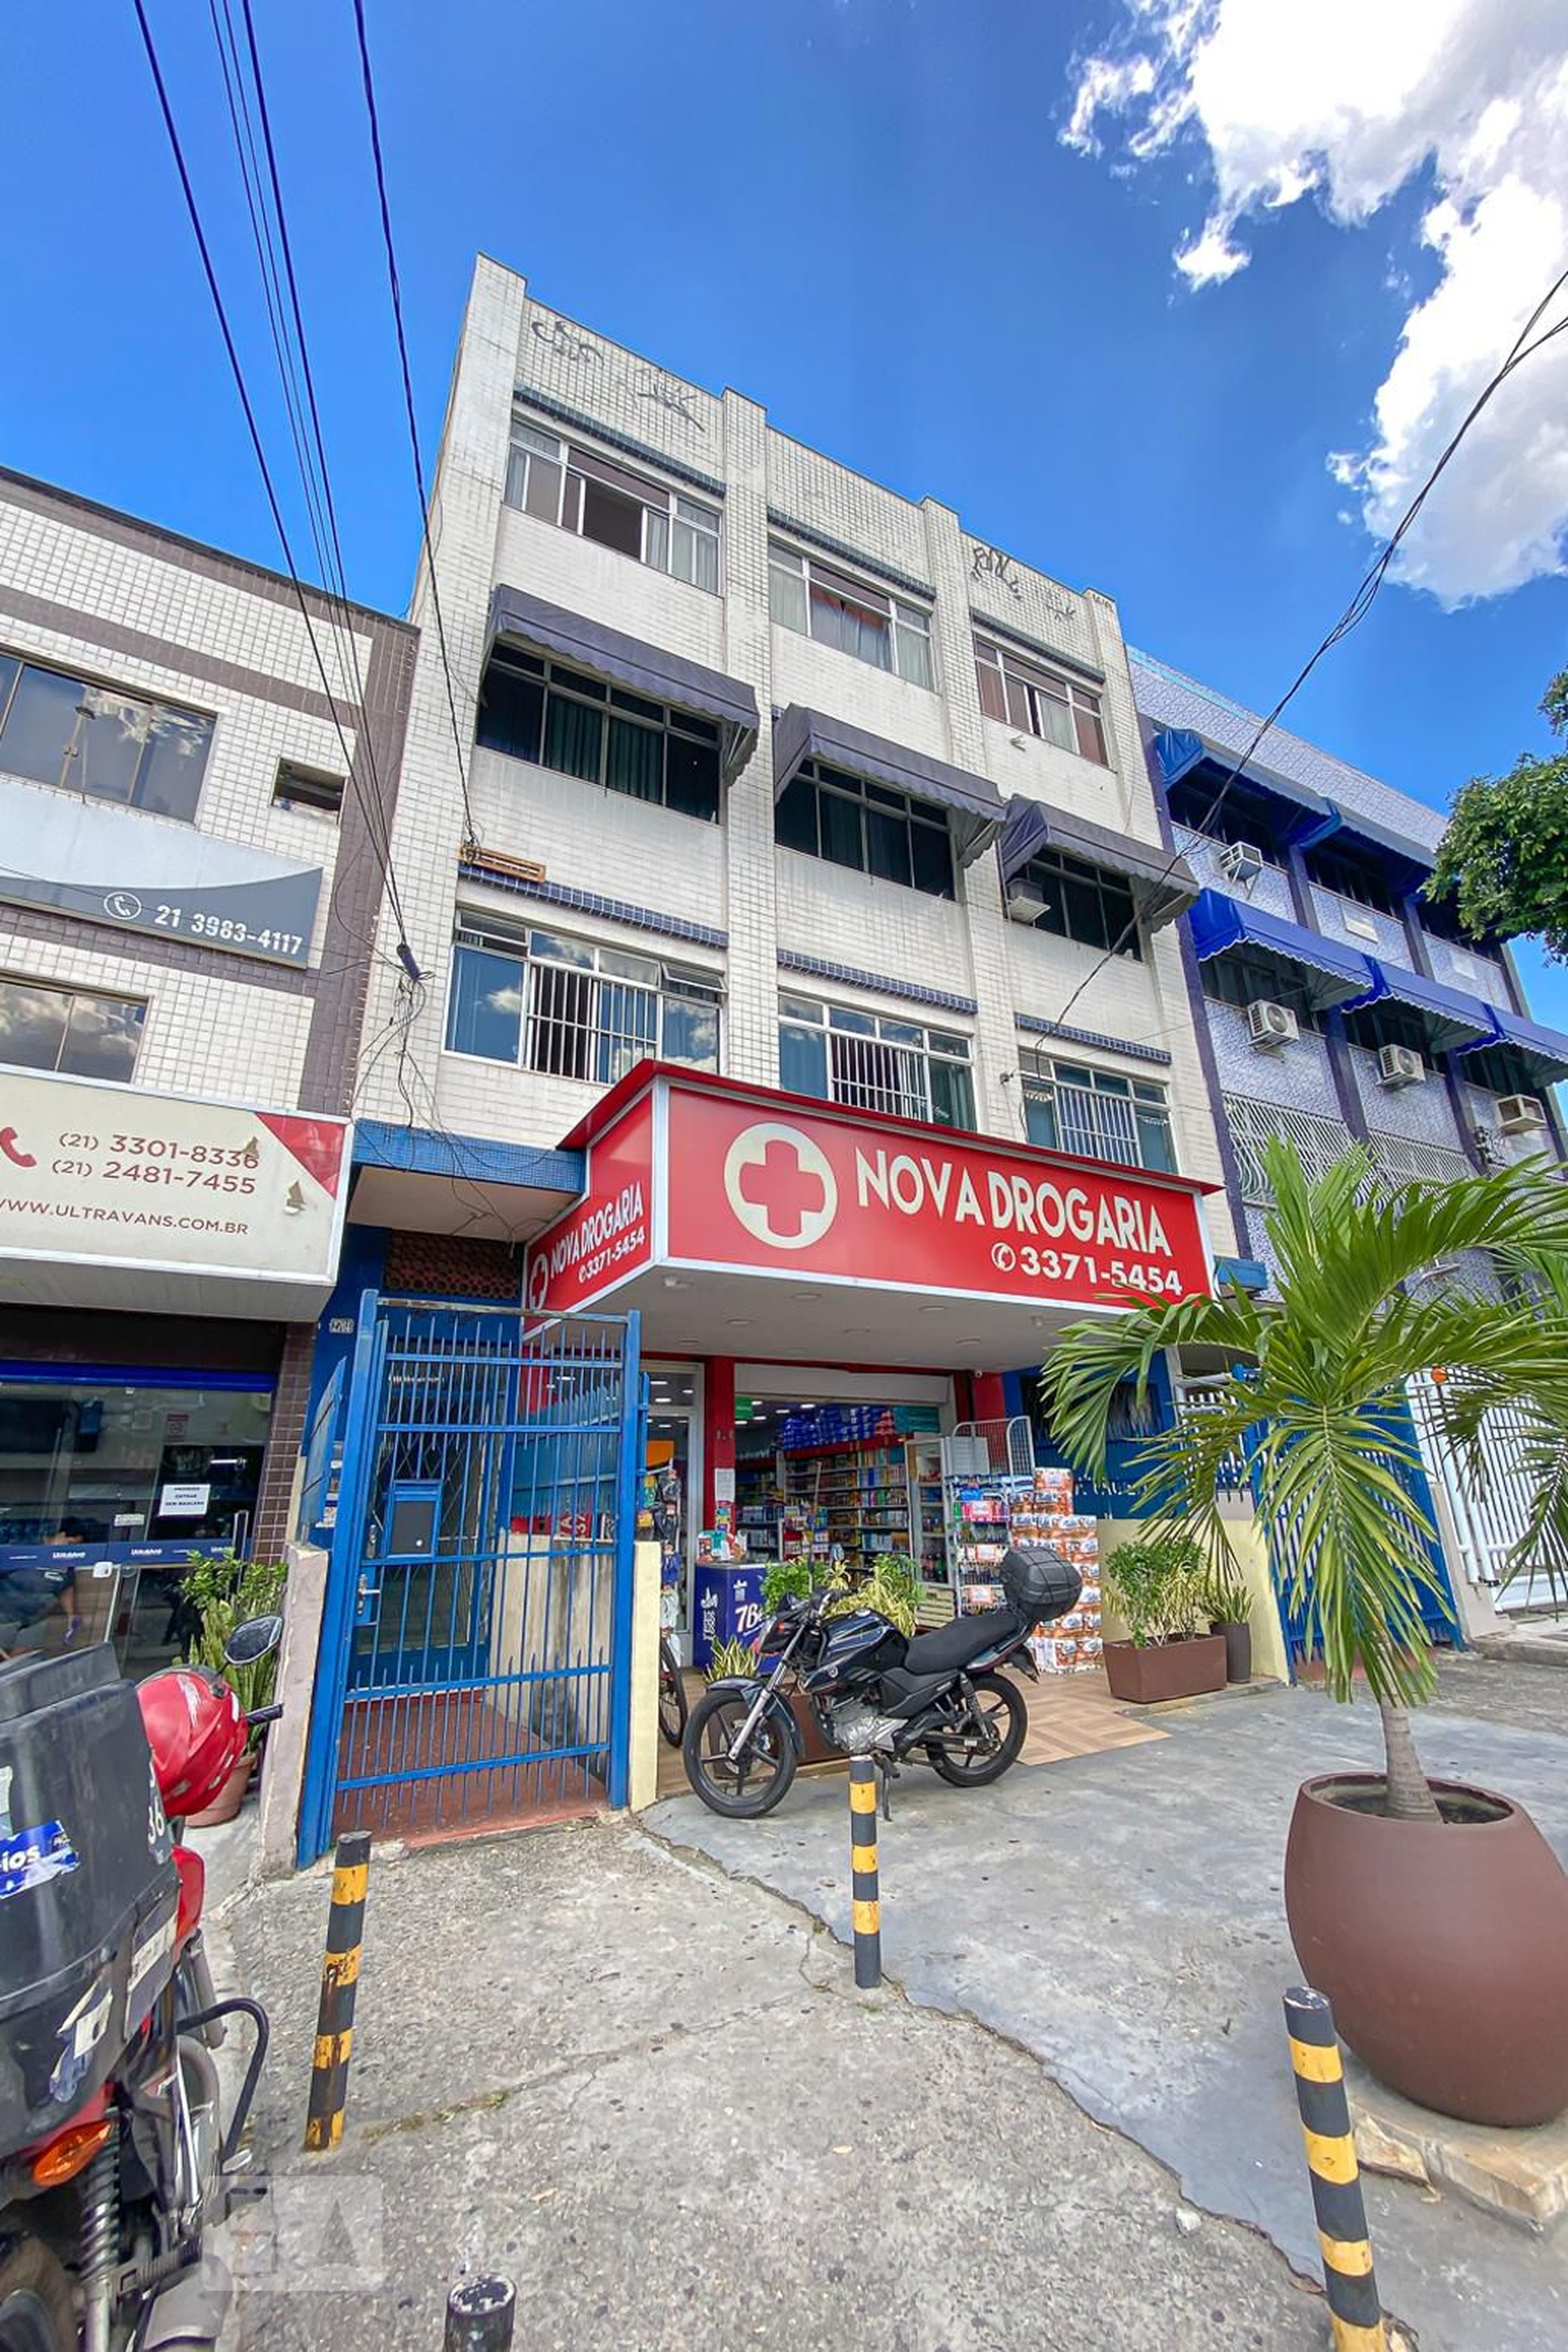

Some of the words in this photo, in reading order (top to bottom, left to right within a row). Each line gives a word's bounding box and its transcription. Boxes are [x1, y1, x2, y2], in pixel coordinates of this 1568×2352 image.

[154, 904, 182, 928] 21
[191, 913, 303, 955] 3983-4117
[59, 1133, 99, 1151] (21)
[110, 1134, 258, 1169] 3301-8336
[52, 1160, 92, 1178] (21)
[102, 1161, 256, 1194] 2481-7455
[587, 1225, 645, 1279] 3371-5454
[1020, 1245, 1183, 1296] 3371-5454
